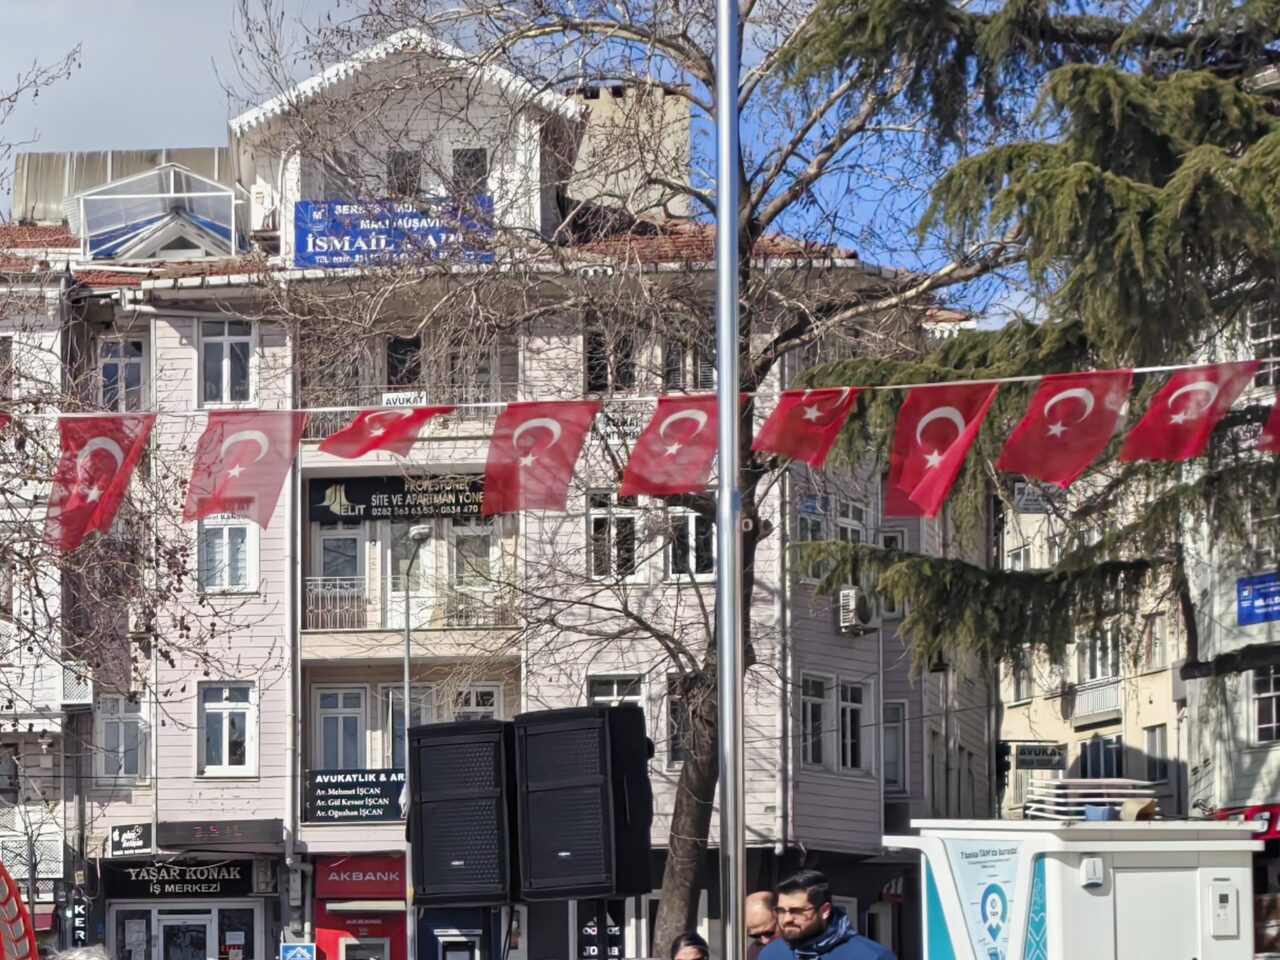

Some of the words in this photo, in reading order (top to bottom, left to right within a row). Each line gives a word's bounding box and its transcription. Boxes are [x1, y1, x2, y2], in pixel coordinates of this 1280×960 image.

[306, 232, 395, 253] İSMAİL
[371, 491, 389, 506] SİTE
[391, 494, 403, 505] VE
[315, 773, 376, 783] AVUKATLIK
[379, 773, 387, 782] &
[328, 788, 356, 796] Mehmet
[356, 786, 381, 796] İŞCAN
[328, 798, 341, 806] Gül
[365, 797, 389, 807] İŞCAN
[359, 807, 384, 817] İŞCAN
[127, 866, 180, 883] YAŞAR
[185, 866, 241, 880] KONAK
[328, 871, 400, 881] AKBANK
[149, 881, 161, 895] İŞ
[165, 881, 220, 893] MERKEZİ
